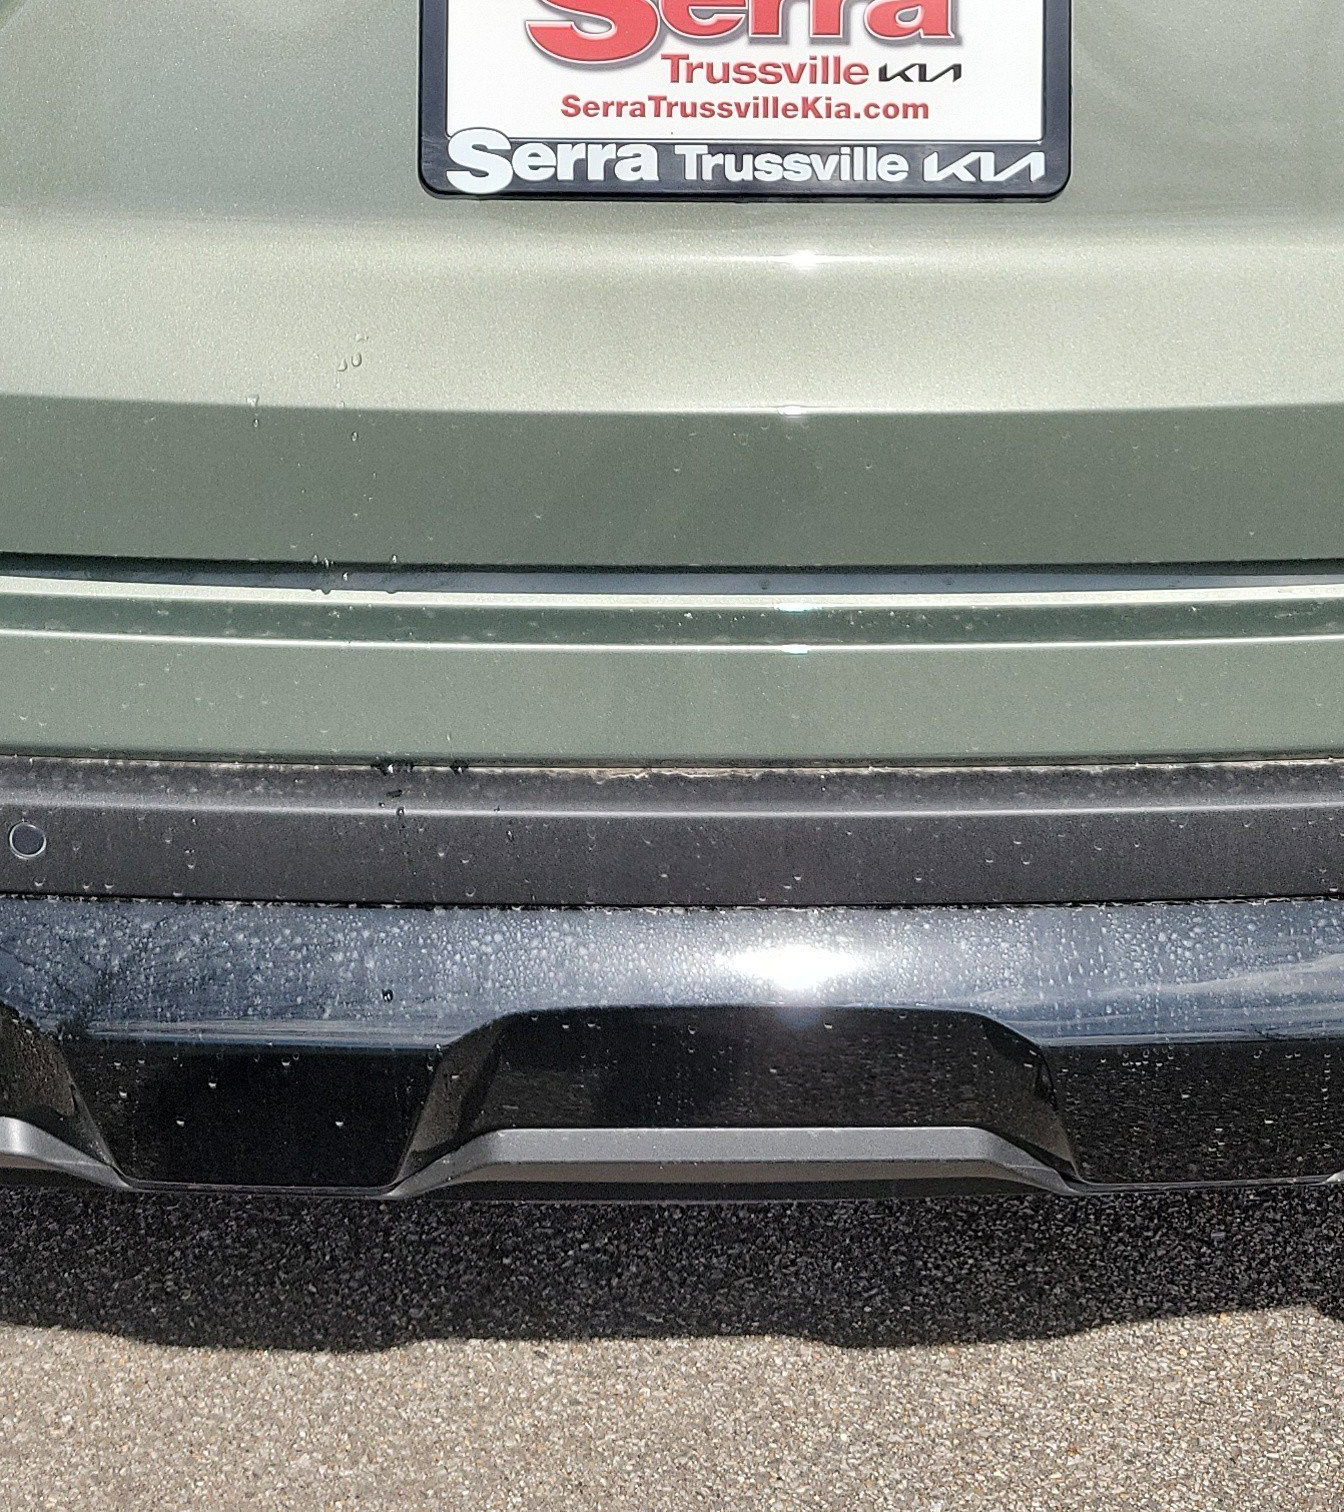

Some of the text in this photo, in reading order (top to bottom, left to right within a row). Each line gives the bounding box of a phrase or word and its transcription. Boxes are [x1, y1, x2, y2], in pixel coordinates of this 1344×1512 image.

[660, 53, 869, 86] Trussville
[560, 95, 930, 121] SerraTrussvilleKia.com
[447, 128, 660, 195] Serra
[675, 144, 909, 183] Trussville
